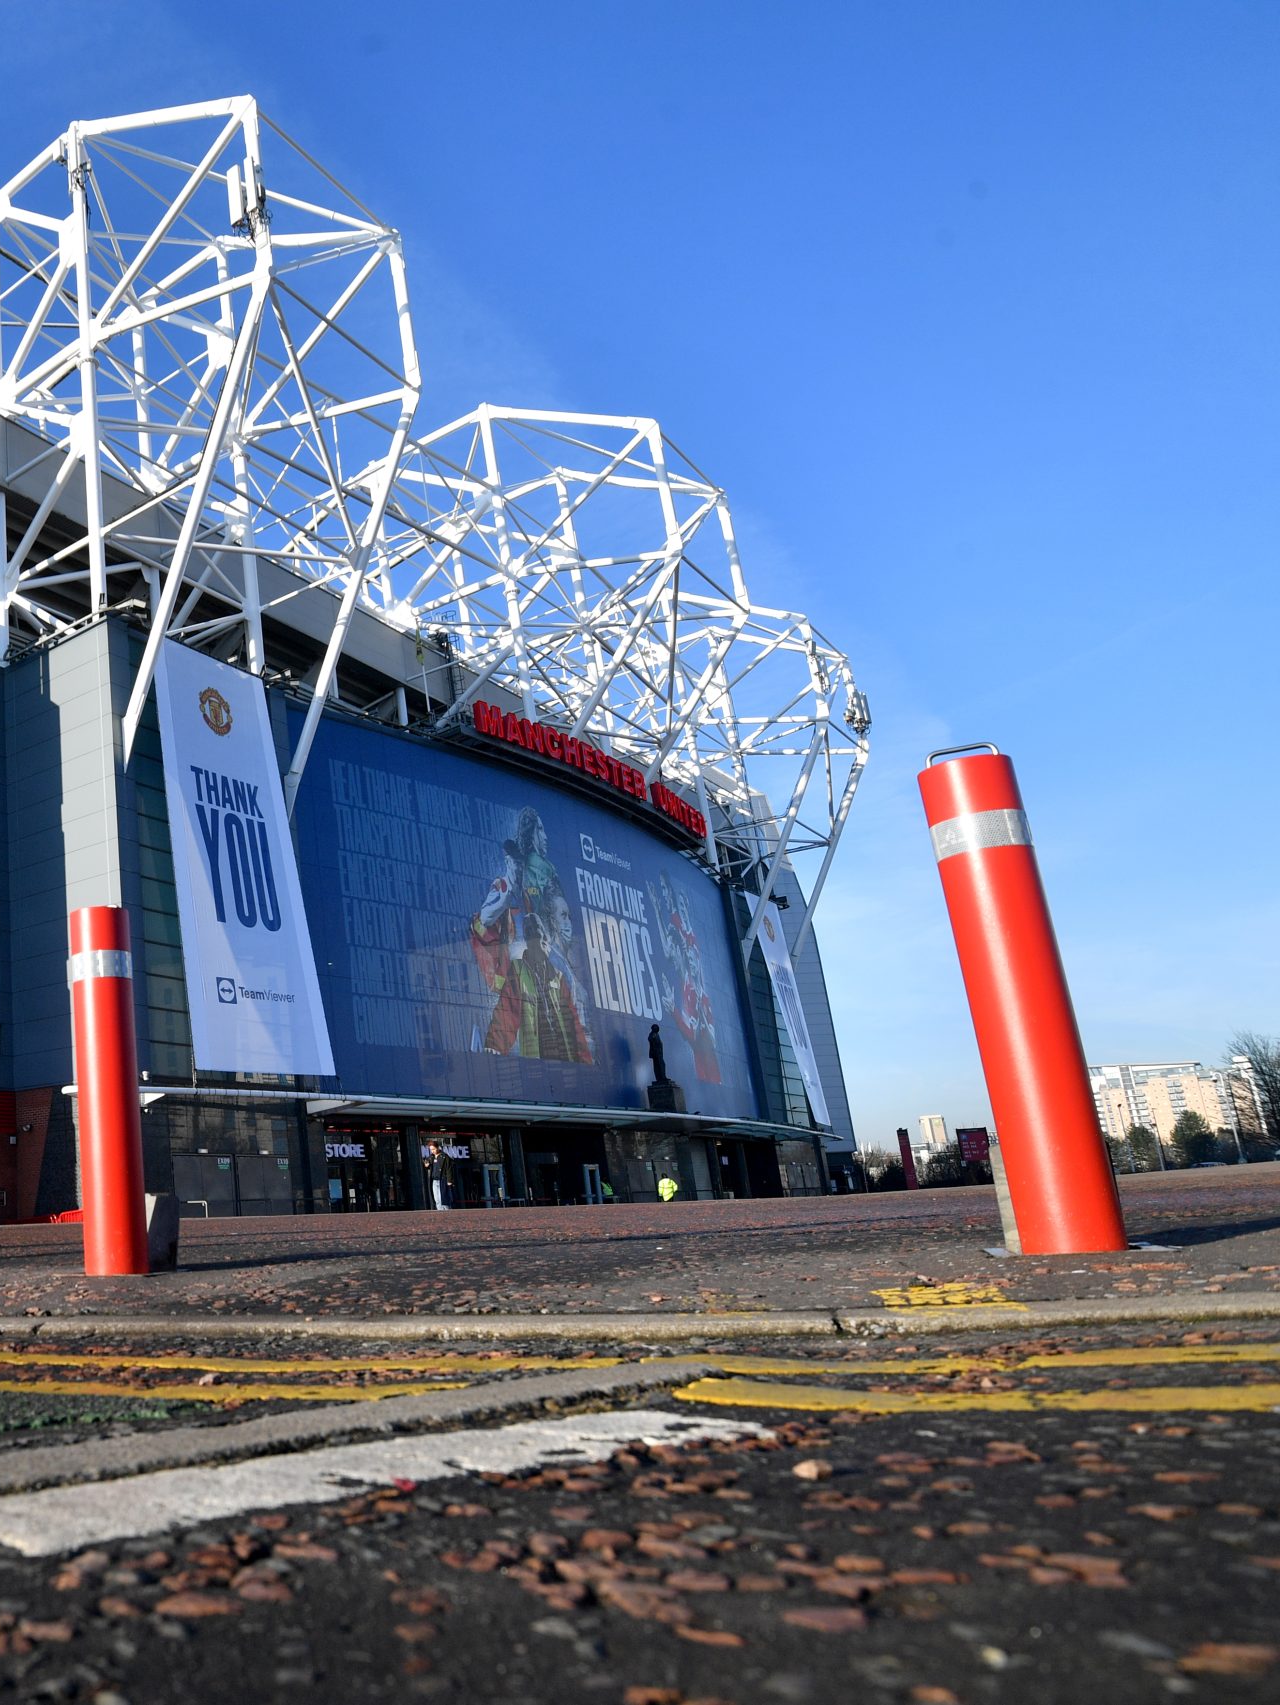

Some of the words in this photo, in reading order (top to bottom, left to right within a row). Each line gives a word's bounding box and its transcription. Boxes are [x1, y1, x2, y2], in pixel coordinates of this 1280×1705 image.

[190, 765, 264, 819] THANK
[328, 758, 415, 821] HEALTHCARE
[414, 779, 473, 835] WORKERS
[473, 700, 647, 801] MANCHESTER
[650, 780, 707, 839] UNITED
[333, 803, 449, 871] TRANSPORTATION
[595, 846, 632, 871] TeamViewer
[195, 803, 283, 932] YOU
[338, 850, 424, 909] EMERGENCY
[575, 867, 648, 924] FRONTLINE
[342, 896, 408, 951] FACTORY
[350, 945, 395, 999] ARMED
[580, 906, 663, 1022] HEROES
[238, 986, 296, 1004] TeamViewer
[325, 1143, 366, 1158] STORE
[421, 1144, 470, 1159] NANCE
